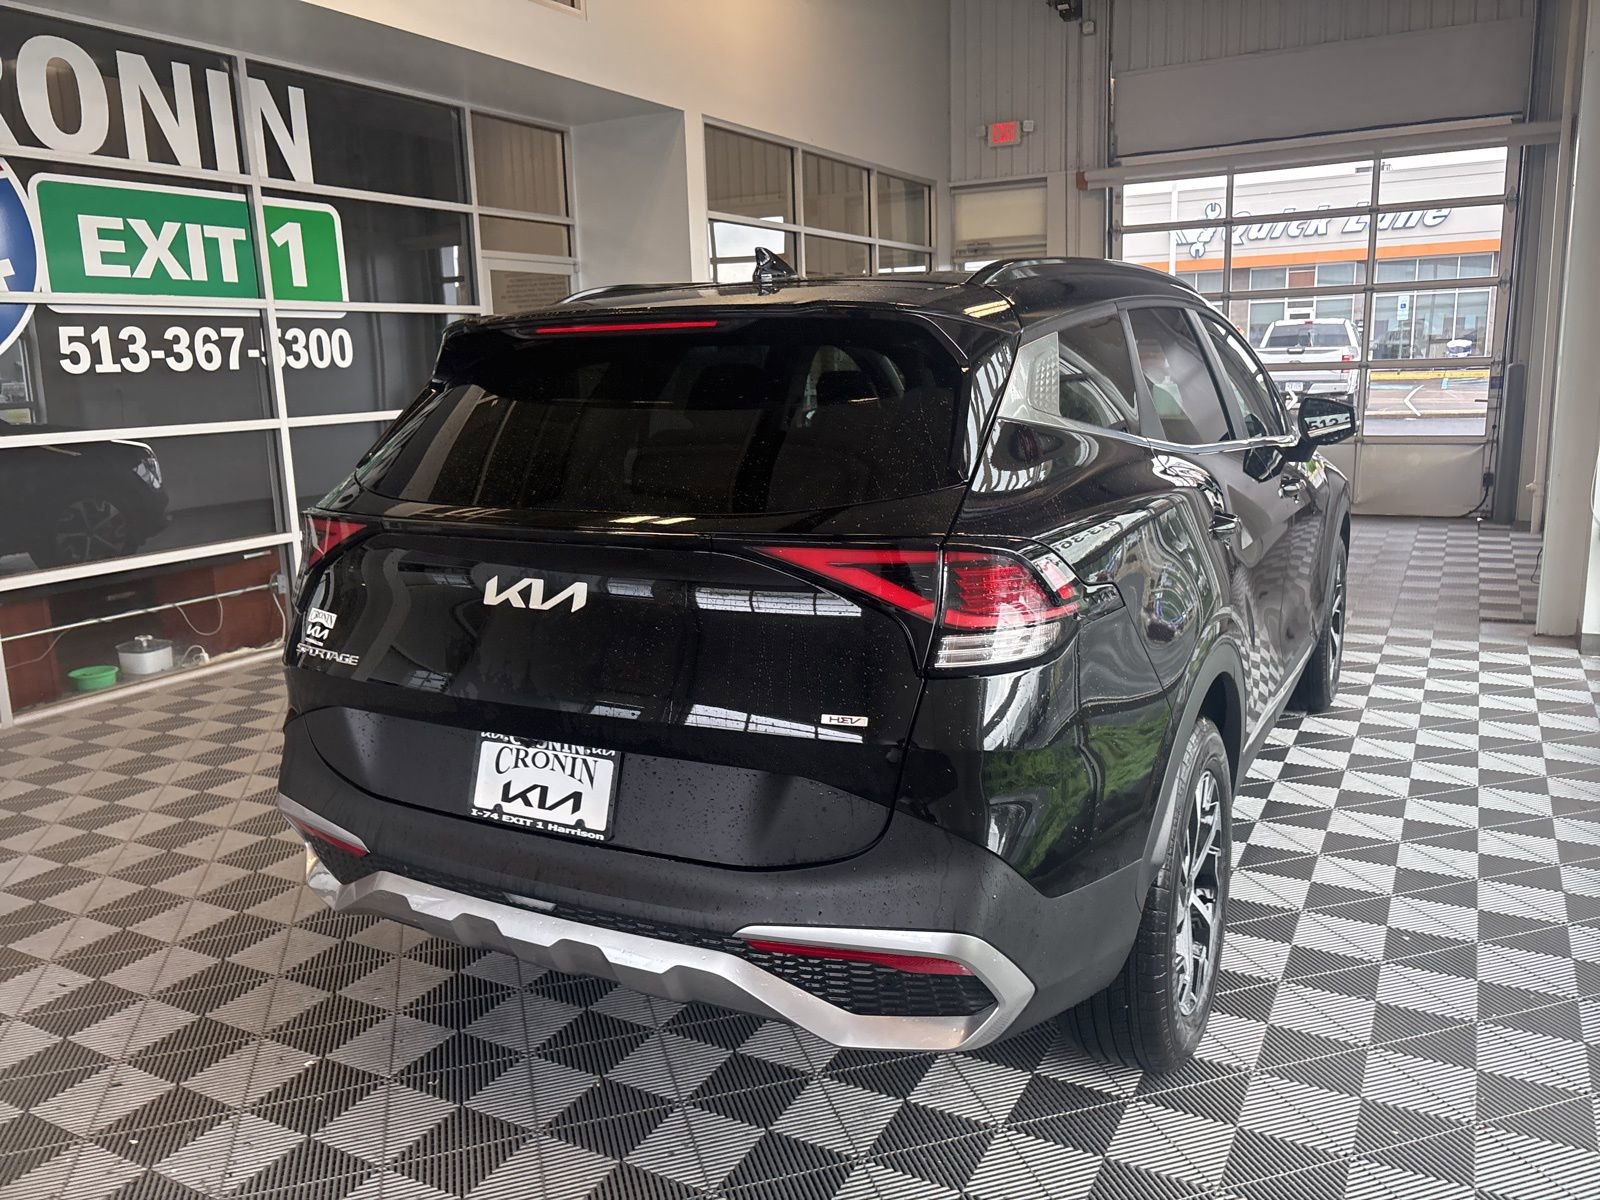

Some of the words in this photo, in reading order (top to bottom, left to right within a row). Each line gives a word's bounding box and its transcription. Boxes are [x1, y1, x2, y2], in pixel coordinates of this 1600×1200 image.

[0, 34, 314, 185] ONIN
[77, 214, 247, 284] EXIT
[270, 221, 309, 288] 1
[483, 575, 588, 613] KIA
[495, 745, 599, 790] CRONIN
[500, 780, 583, 815] KIA
[471, 808, 499, 820] I-74
[502, 814, 534, 827] EXIT
[536, 821, 544, 829] 1
[548, 823, 605, 841] Harrison
